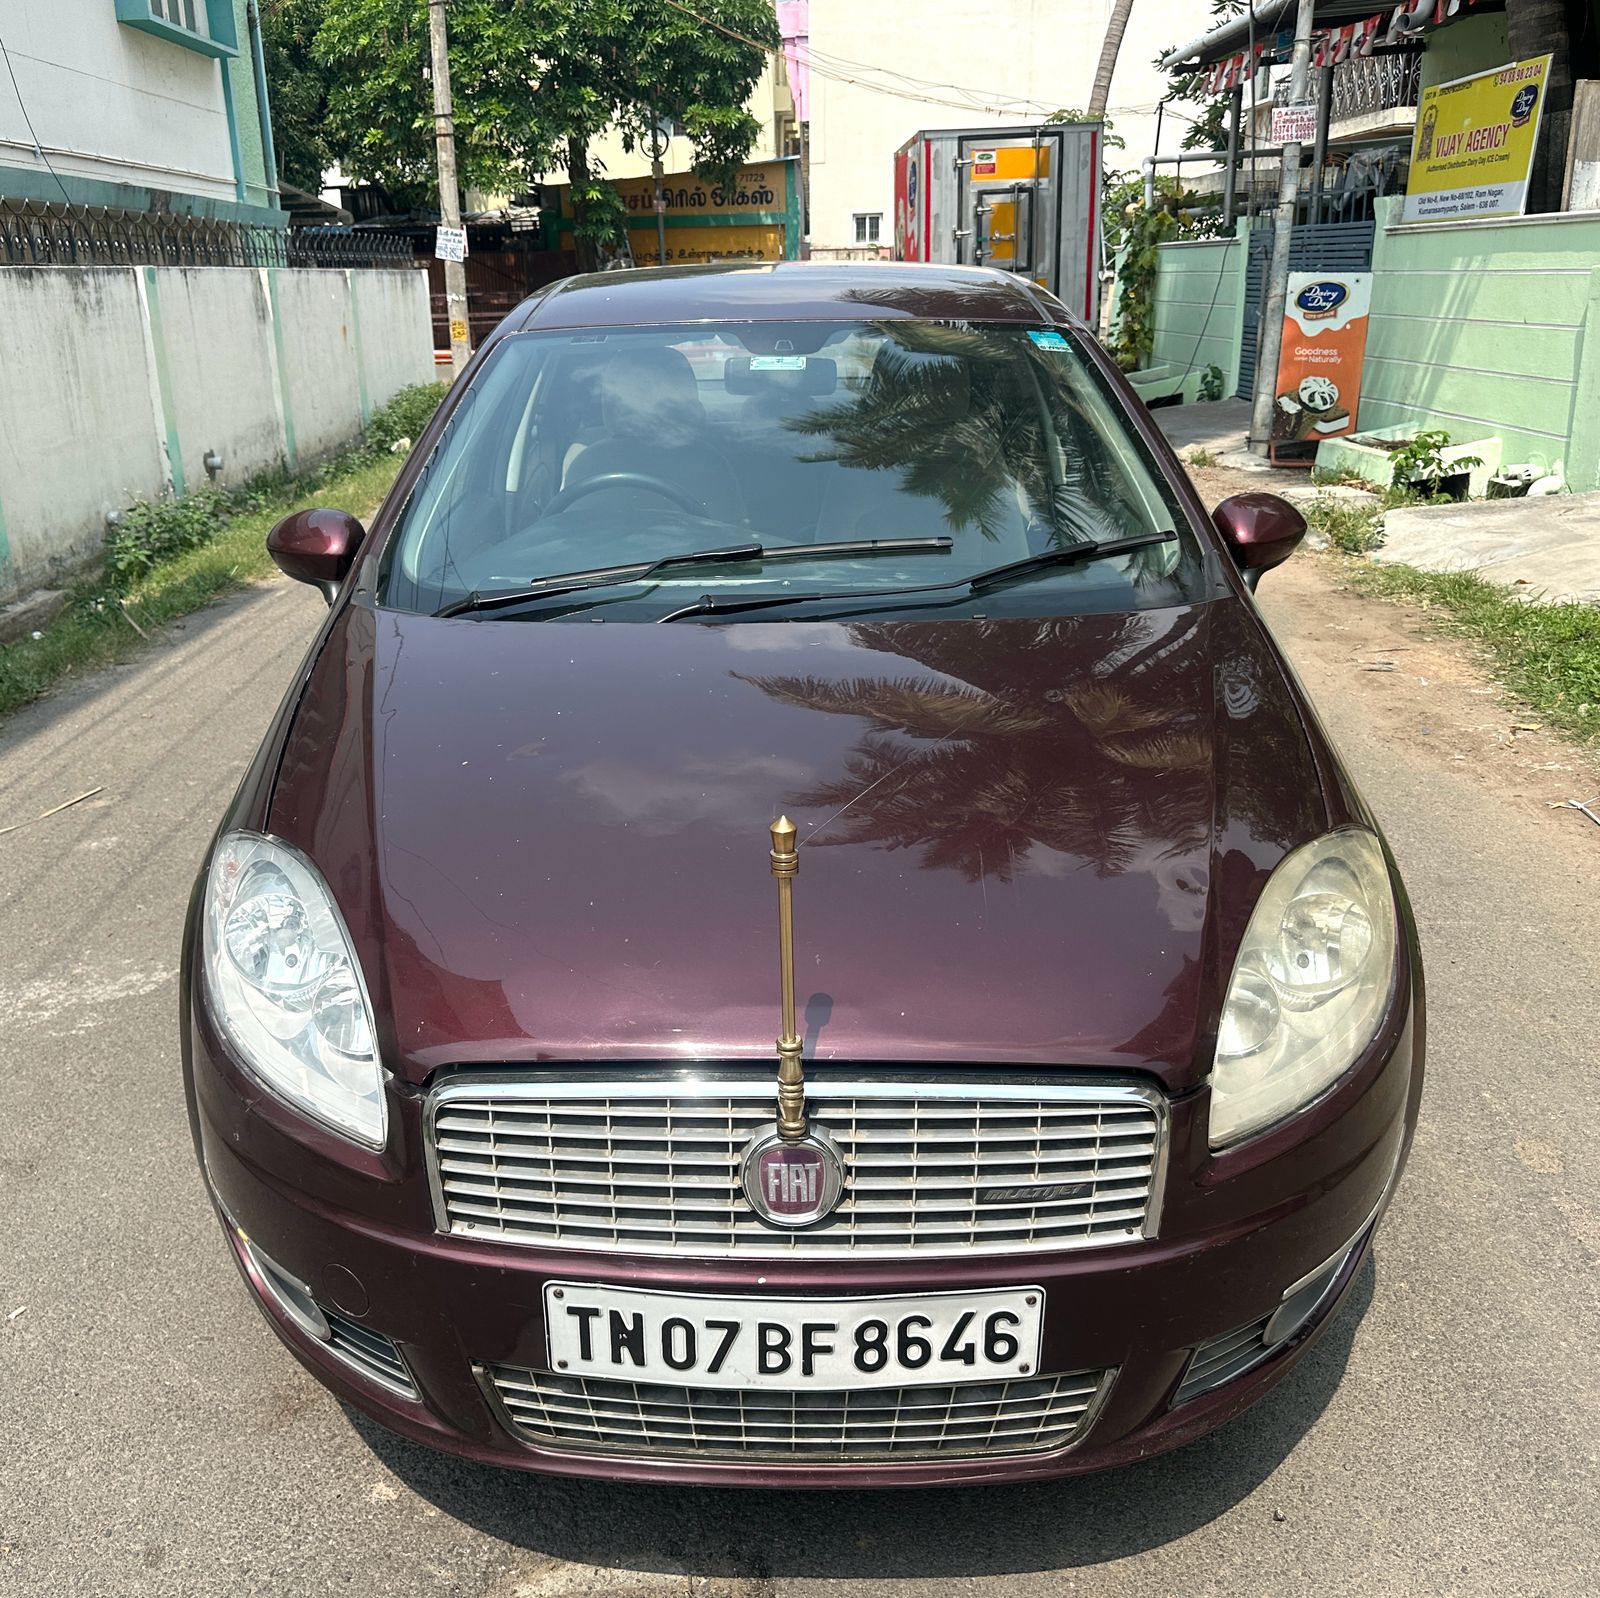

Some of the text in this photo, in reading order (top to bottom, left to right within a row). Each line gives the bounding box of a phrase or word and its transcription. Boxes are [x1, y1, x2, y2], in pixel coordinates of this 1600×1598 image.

[1516, 90, 1534, 105] Dairy
[1516, 101, 1530, 115] Day
[1435, 123, 1511, 158] VIJAY AGENCY
[1460, 202, 1475, 211] Salem
[1304, 285, 1339, 300] Dairy
[1307, 296, 1333, 311] Day
[1294, 346, 1338, 356] Goodness
[1309, 355, 1342, 365] Naturally
[766, 1161, 821, 1203] FIAT
[566, 1305, 1021, 1376] TN 07 BF 8646
